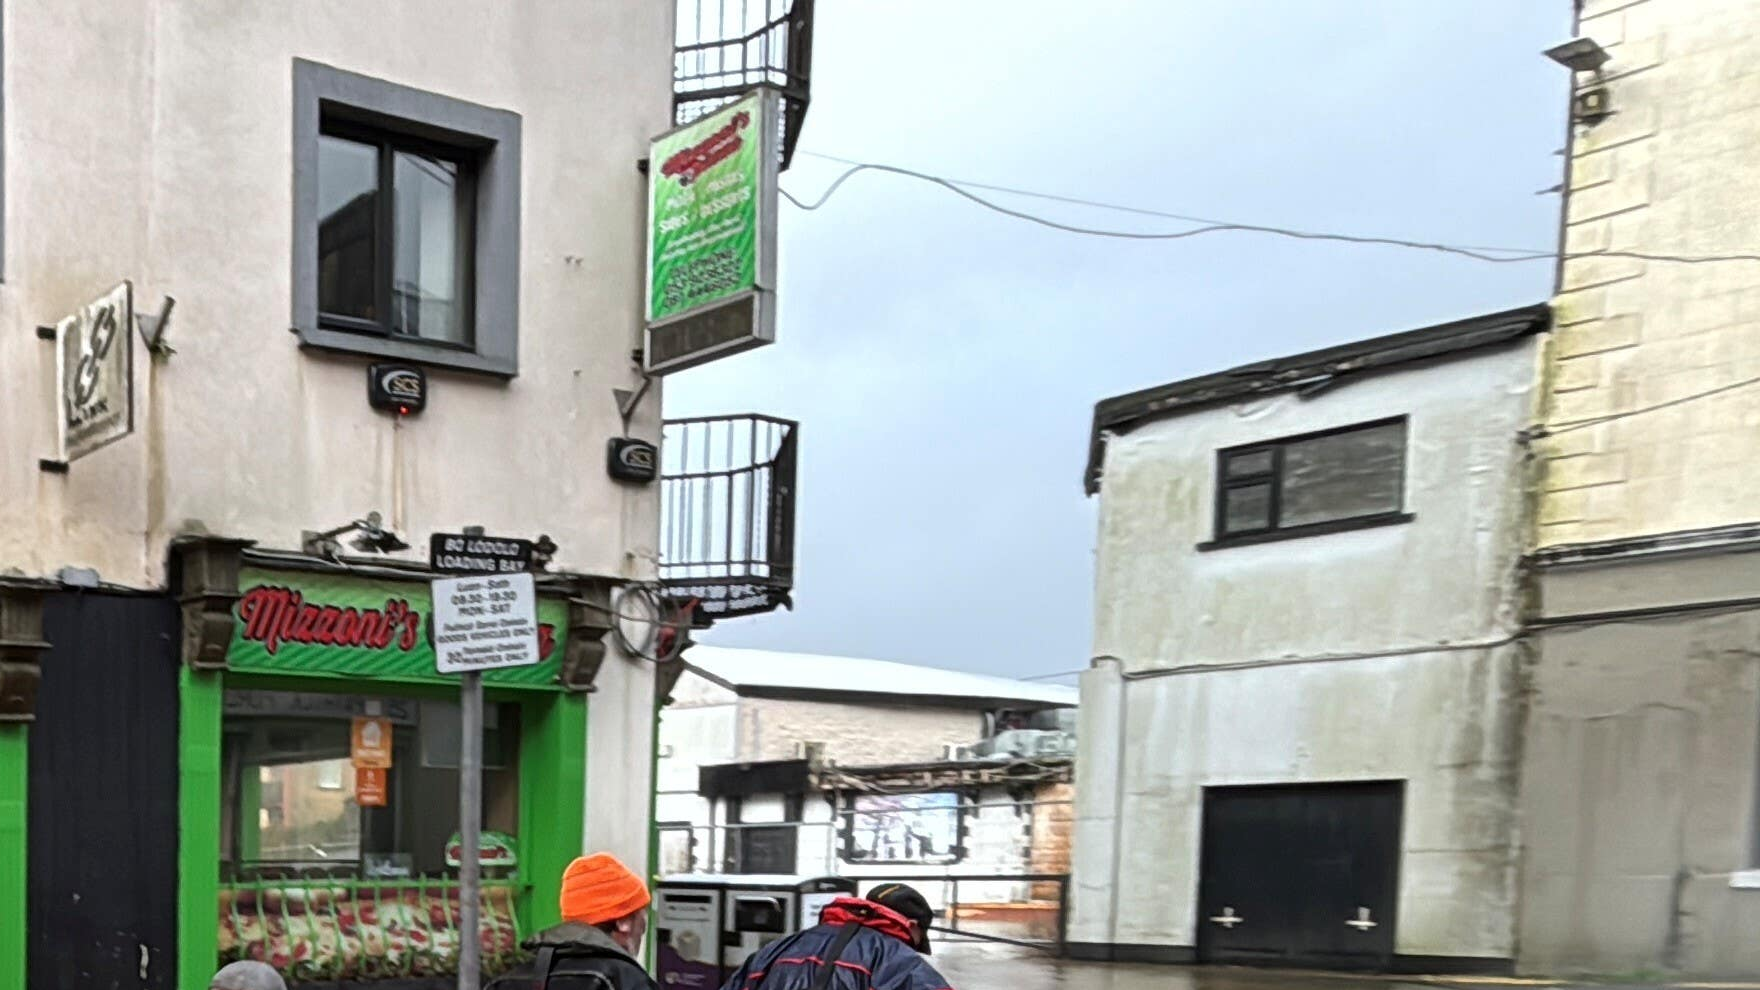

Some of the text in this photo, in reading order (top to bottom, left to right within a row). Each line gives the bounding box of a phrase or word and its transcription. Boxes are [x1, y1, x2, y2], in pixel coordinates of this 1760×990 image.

[436, 555, 526, 572] LOADING BAY
[241, 584, 421, 655] Mizzoni's
